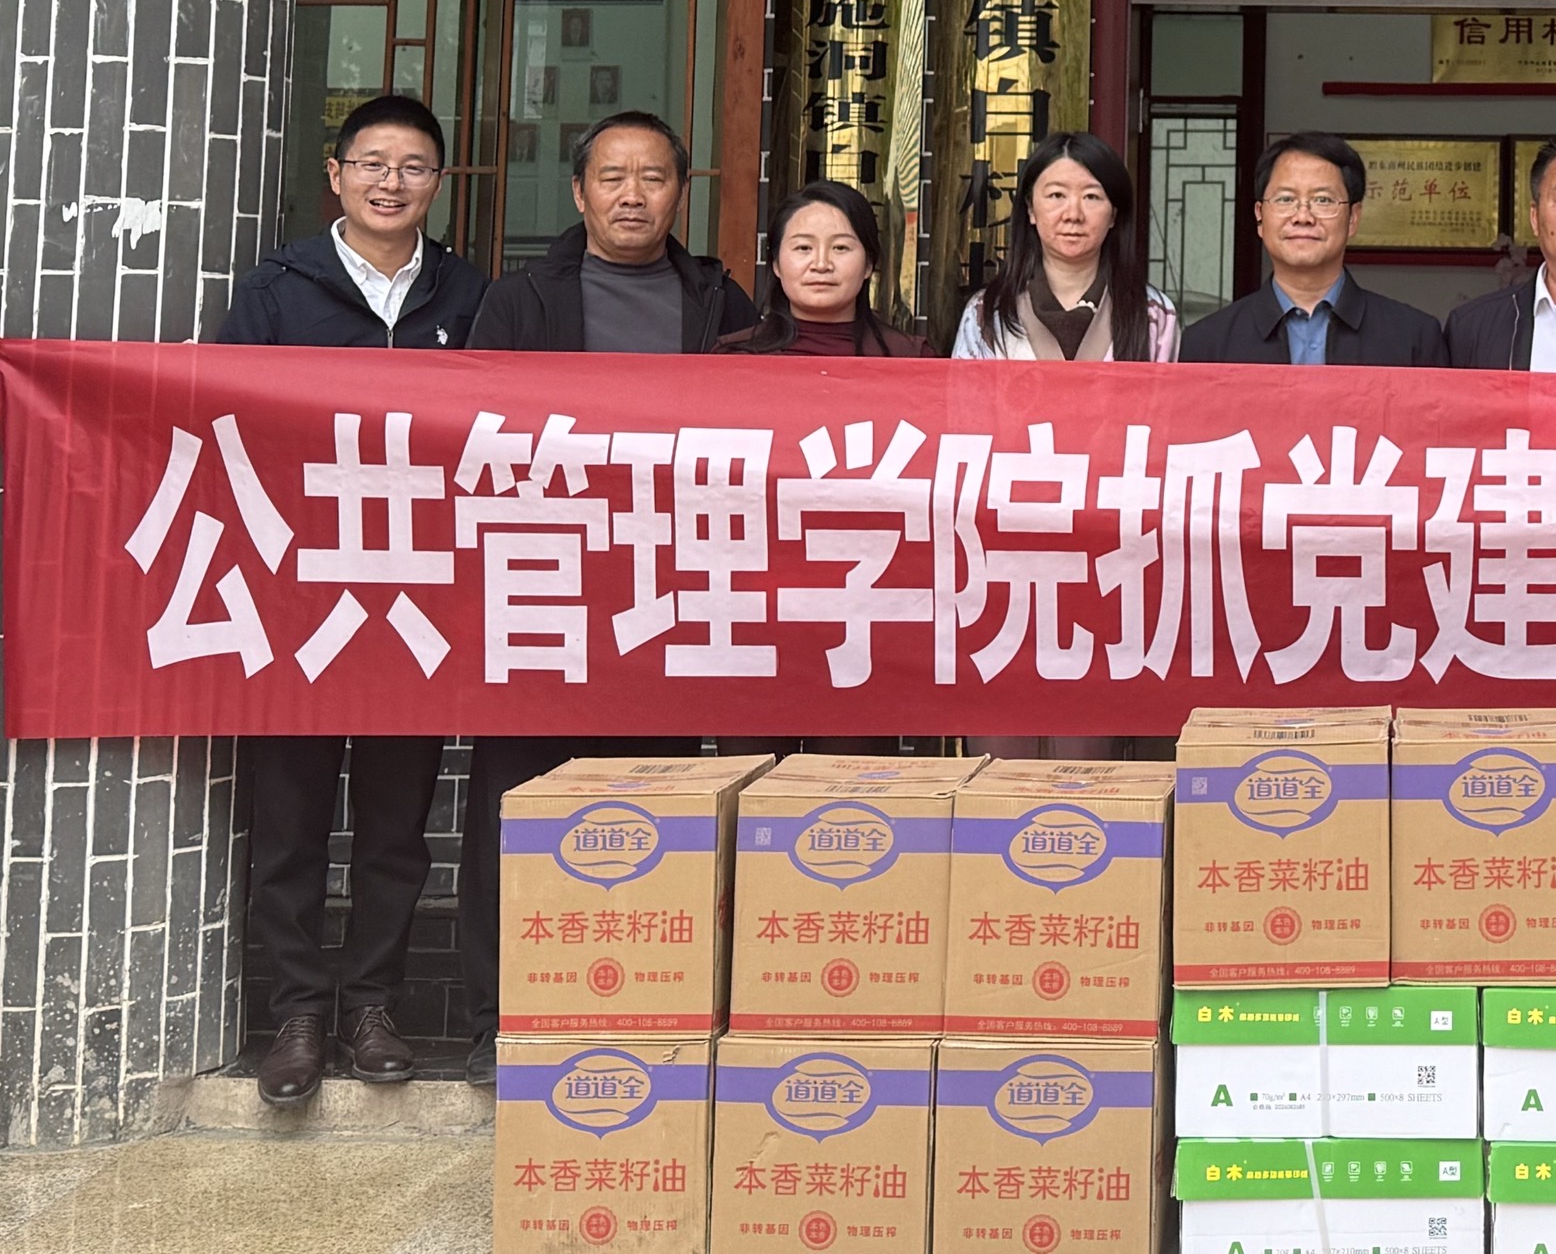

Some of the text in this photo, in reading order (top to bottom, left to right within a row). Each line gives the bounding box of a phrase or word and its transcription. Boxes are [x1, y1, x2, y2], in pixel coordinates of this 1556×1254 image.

[1366, 178, 1472, 203] 示范单位
[1248, 776, 1325, 801] 道道全
[1462, 774, 1538, 798] 道道全
[573, 828, 652, 852] 道道全
[808, 828, 887, 852] 道道全
[1022, 830, 1100, 855] 道道全
[1198, 857, 1368, 894] 本香菜籽油
[520, 909, 693, 945] 本香菜籽油
[756, 910, 930, 945] 本香菜籽油
[968, 911, 1139, 949] 本香菜籽油
[1204, 919, 1361, 933] 非转基因 物理压榨
[1420, 918, 1470, 930] 非转基因
[527, 971, 684, 983] 非转基因 物理压榨
[761, 972, 920, 984] 非转基因 物理压榨
[973, 973, 1130, 988] 非转基因 物理压榨
[1197, 1005, 1234, 1023] 白木
[1507, 1008, 1543, 1025] 白木
[565, 1075, 645, 1099] 道道全
[785, 1079, 864, 1103] 道道全
[1007, 1082, 1087, 1105] 道道全
[1211, 1084, 1233, 1107] A
[1300, 1093, 1312, 1101] A4
[1407, 1093, 1442, 1102] SHEETS
[1521, 1089, 1544, 1111] A
[513, 1157, 686, 1192] 本香菜籽油
[734, 1163, 907, 1198] 本香菜籽油
[957, 1165, 1130, 1201] 本香菜籽油
[1206, 1164, 1243, 1181] 白木
[1515, 1163, 1551, 1180] 白木
[520, 1219, 678, 1232] 非转基因 物理压榨
[739, 1223, 897, 1238] 非转基因 物理压榨
[962, 1227, 1121, 1241] 非转基因 物理压榨
